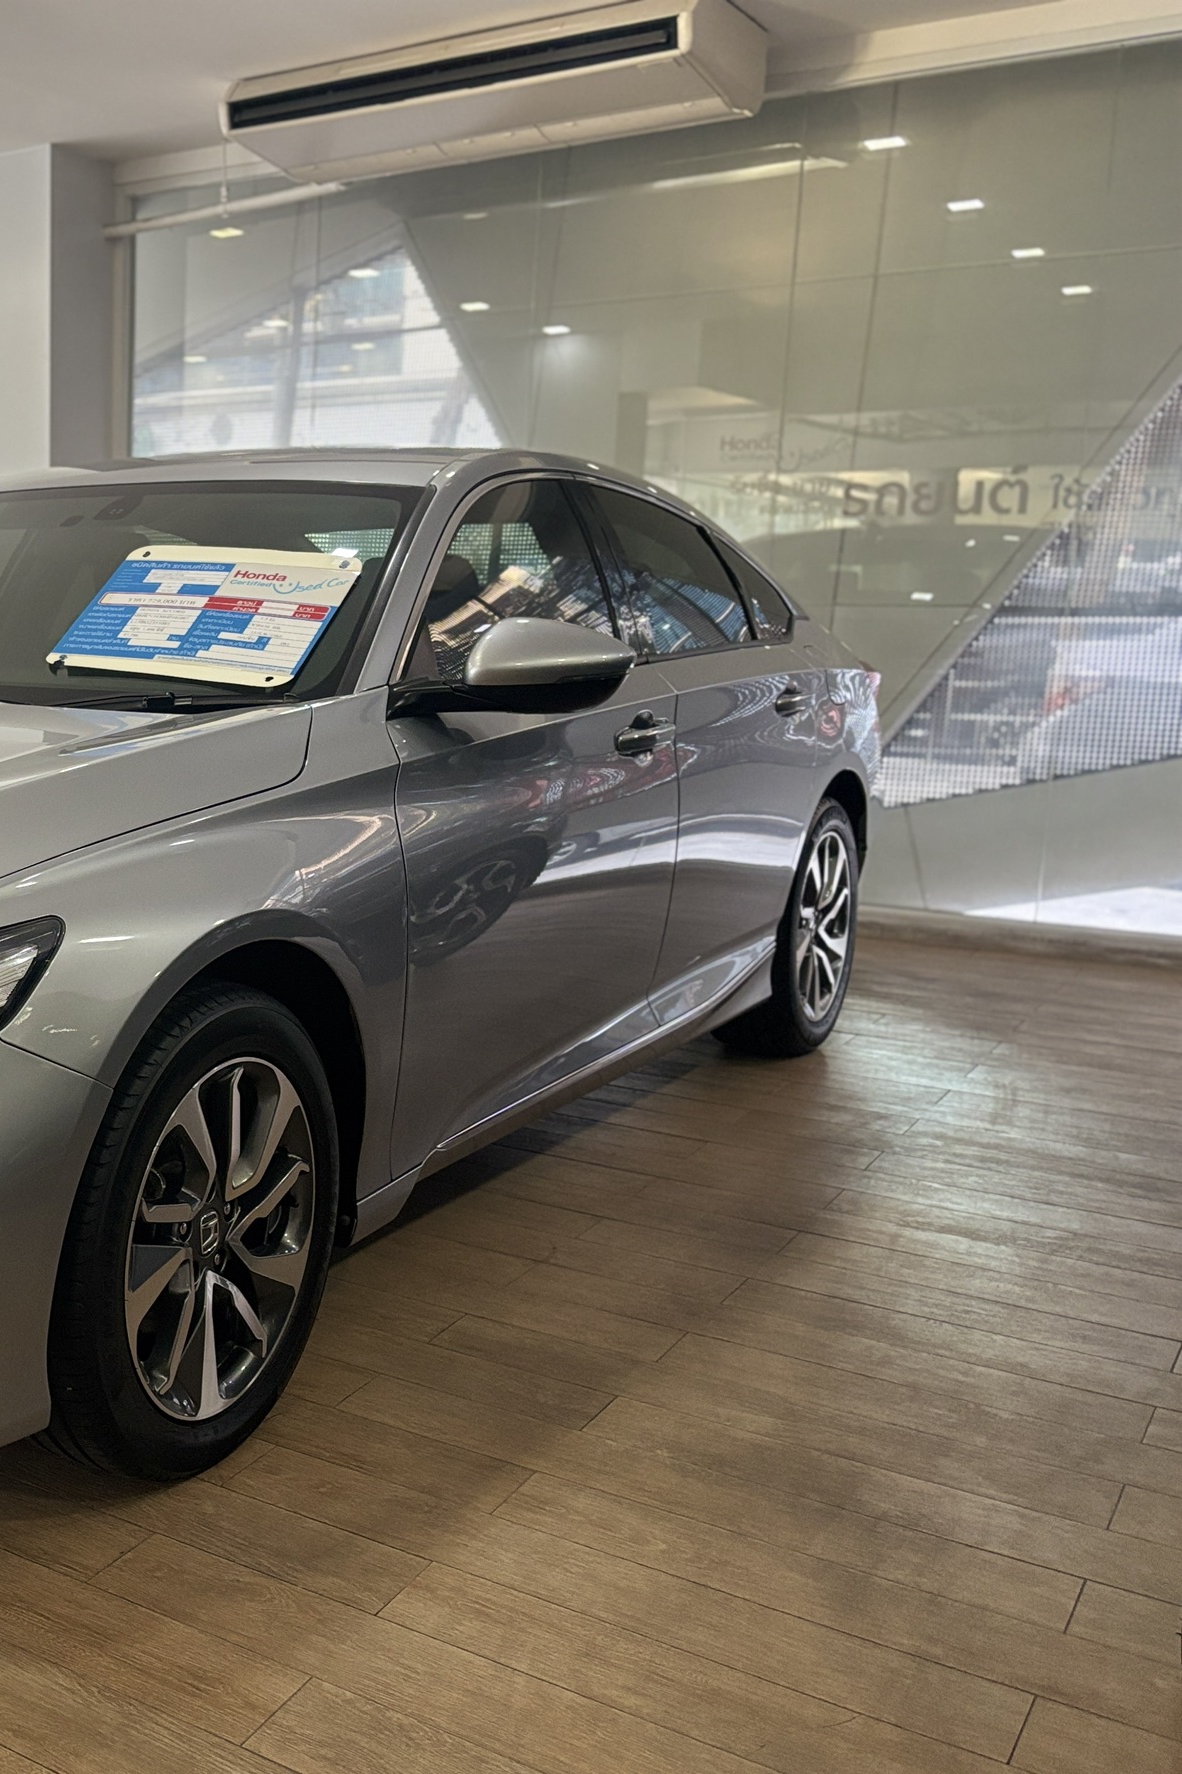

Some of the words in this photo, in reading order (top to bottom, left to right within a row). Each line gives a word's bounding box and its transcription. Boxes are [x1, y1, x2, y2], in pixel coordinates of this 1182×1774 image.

[841, 464, 1029, 518] รถยนต์
[233, 570, 287, 582] Honda
[229, 579, 274, 588] Certified
[272, 579, 326, 595] Used
[326, 577, 350, 589] Car
